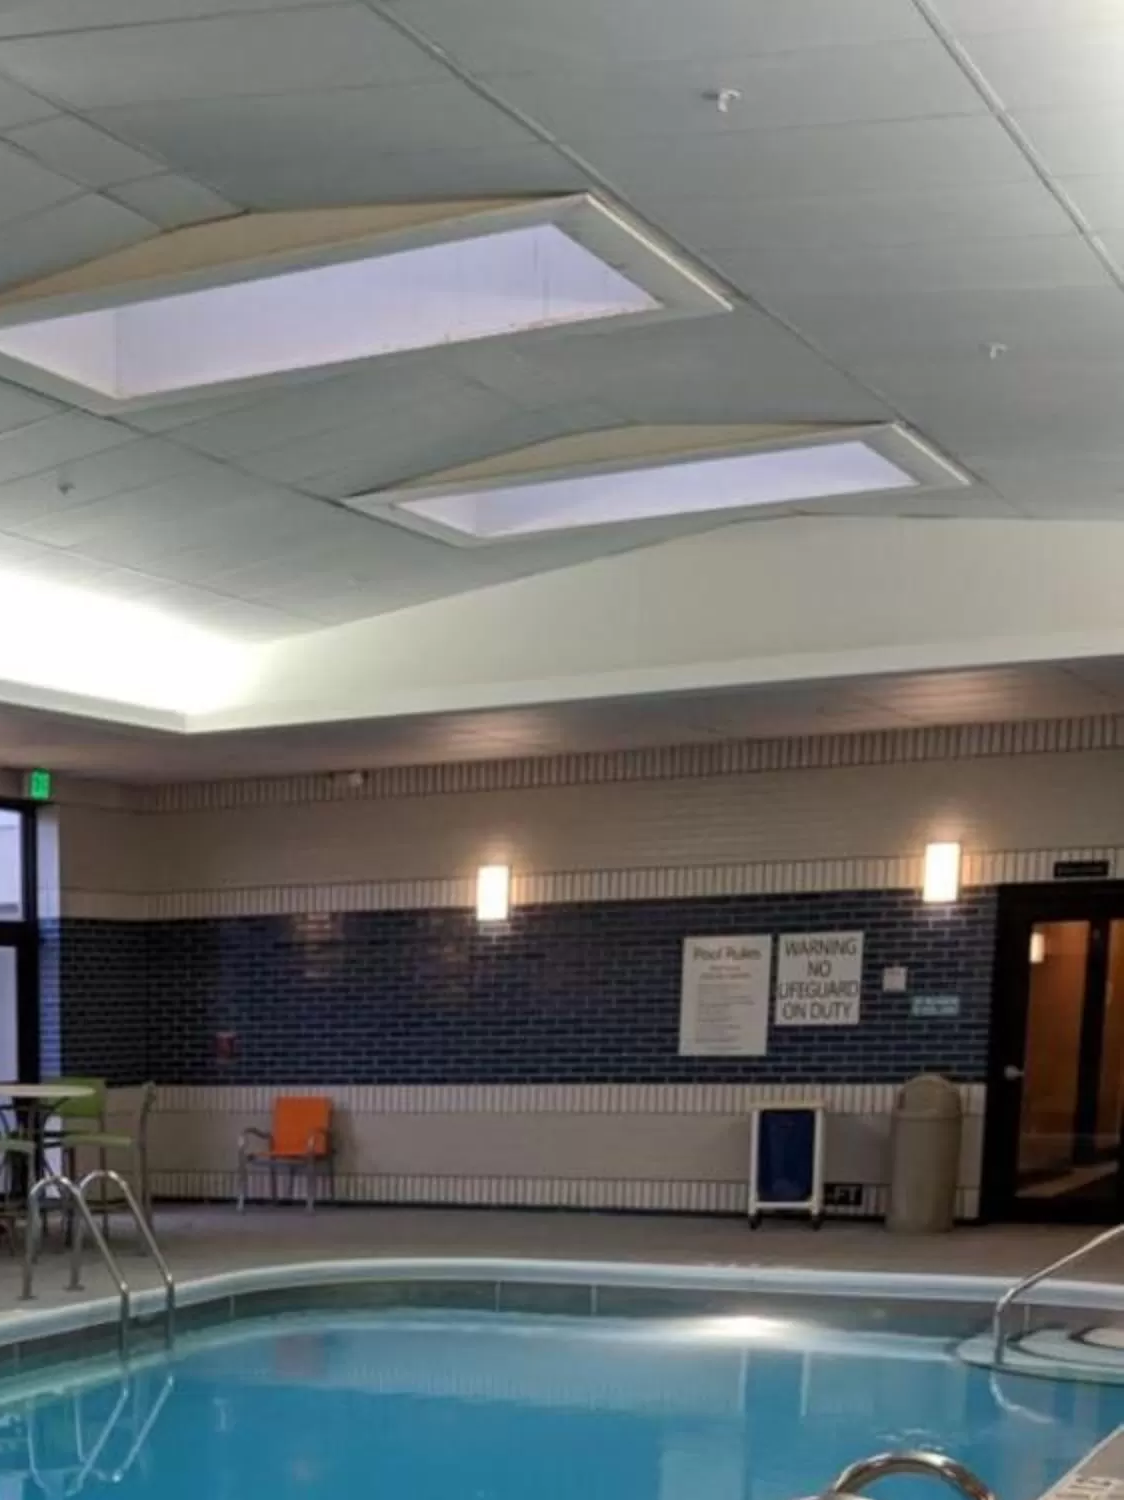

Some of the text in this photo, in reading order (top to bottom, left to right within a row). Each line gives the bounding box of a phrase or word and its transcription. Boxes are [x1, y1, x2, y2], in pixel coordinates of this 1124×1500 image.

[784, 938, 857, 957] WARNING
[807, 960, 832, 977] NO
[778, 980, 859, 1000] LIFEGUARD
[782, 1001, 854, 1020] ON DUTY
